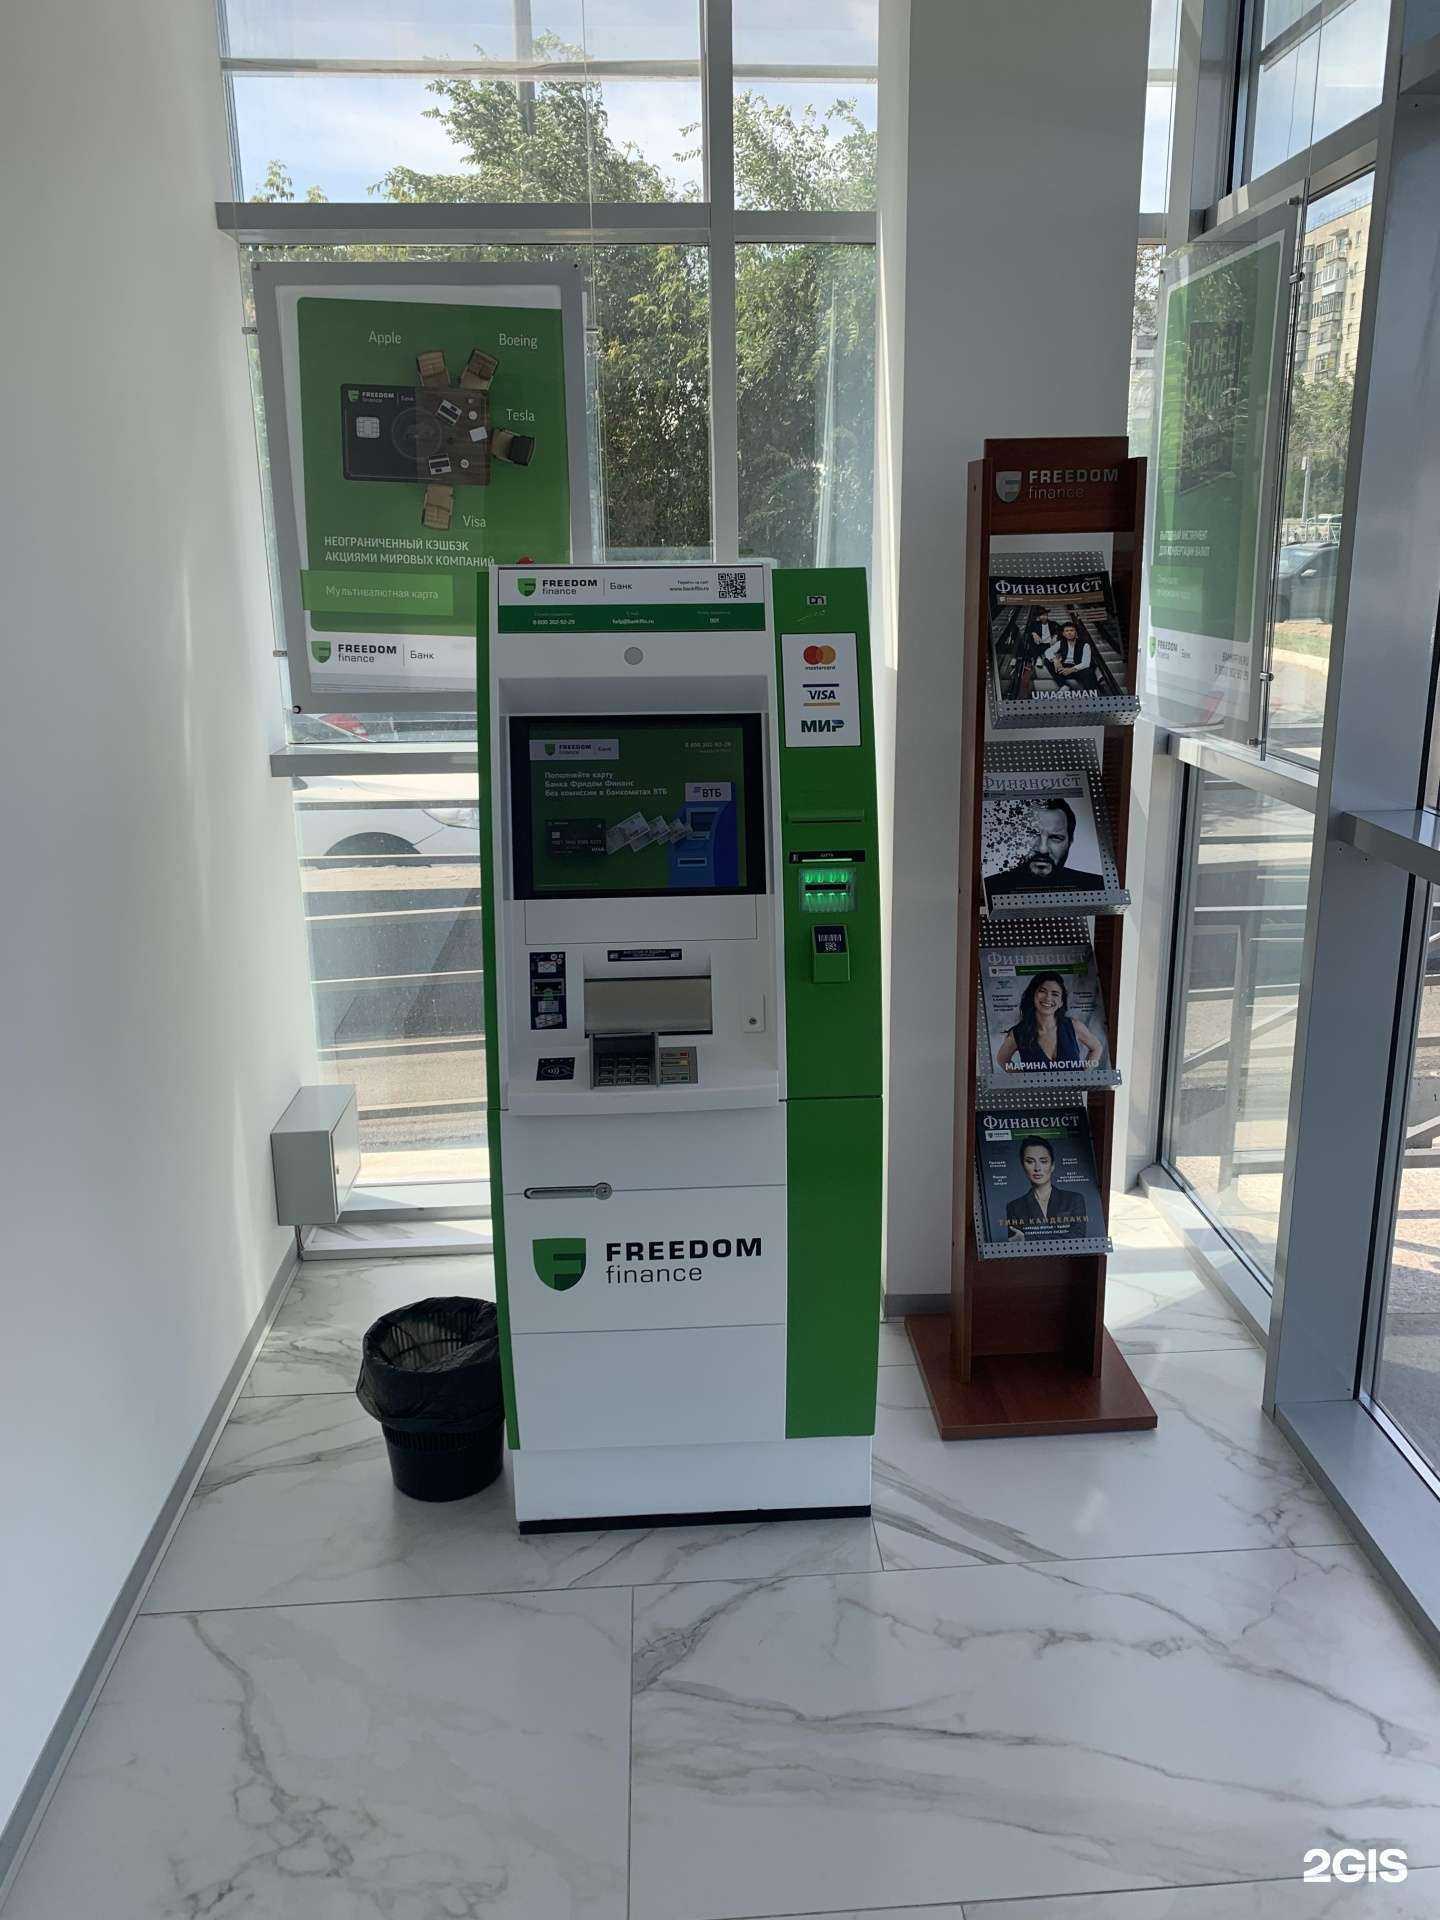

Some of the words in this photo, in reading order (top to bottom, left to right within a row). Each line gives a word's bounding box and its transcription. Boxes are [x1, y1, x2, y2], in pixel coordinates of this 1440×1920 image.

[368, 331, 402, 346] Apple
[499, 333, 538, 350] Boeing
[506, 408, 535, 423] Tesla
[1028, 468, 1119, 484] FREEDOM
[1028, 486, 1085, 500] finance
[462, 514, 487, 529] Visa
[324, 535, 424, 551] НЕОГРАНИЧЕННЫЙ
[425, 540, 470, 552] КЭШБЭК
[325, 551, 378, 563] АКЦИЯМИ
[380, 553, 434, 565] МИРОВЫХ
[435, 555, 496, 567] КОМПАНИЙ
[542, 579, 598, 587] FREEDOM
[609, 582, 633, 590] Банк
[995, 579, 1102, 594] Финансист
[325, 586, 409, 600] Мультивалютная
[411, 590, 439, 601] карта
[542, 587, 577, 595] finance
[338, 643, 397, 654] FREEDOM
[410, 649, 435, 660] Банк
[338, 653, 375, 663] finance
[808, 690, 836, 700] VISA
[1031, 689, 1098, 700] UMA2RMAN
[801, 719, 845, 733] МИР
[569, 779, 603, 789] Фридом
[984, 776, 1081, 791] Финансист
[702, 788, 722, 798] ВТБ
[987, 952, 1088, 965] Финансист
[1005, 1061, 1047, 1071] МАРИНА
[983, 1115, 1080, 1129] Финансист
[605, 1237, 762, 1262] FREEDOM
[605, 1265, 703, 1284] finance
